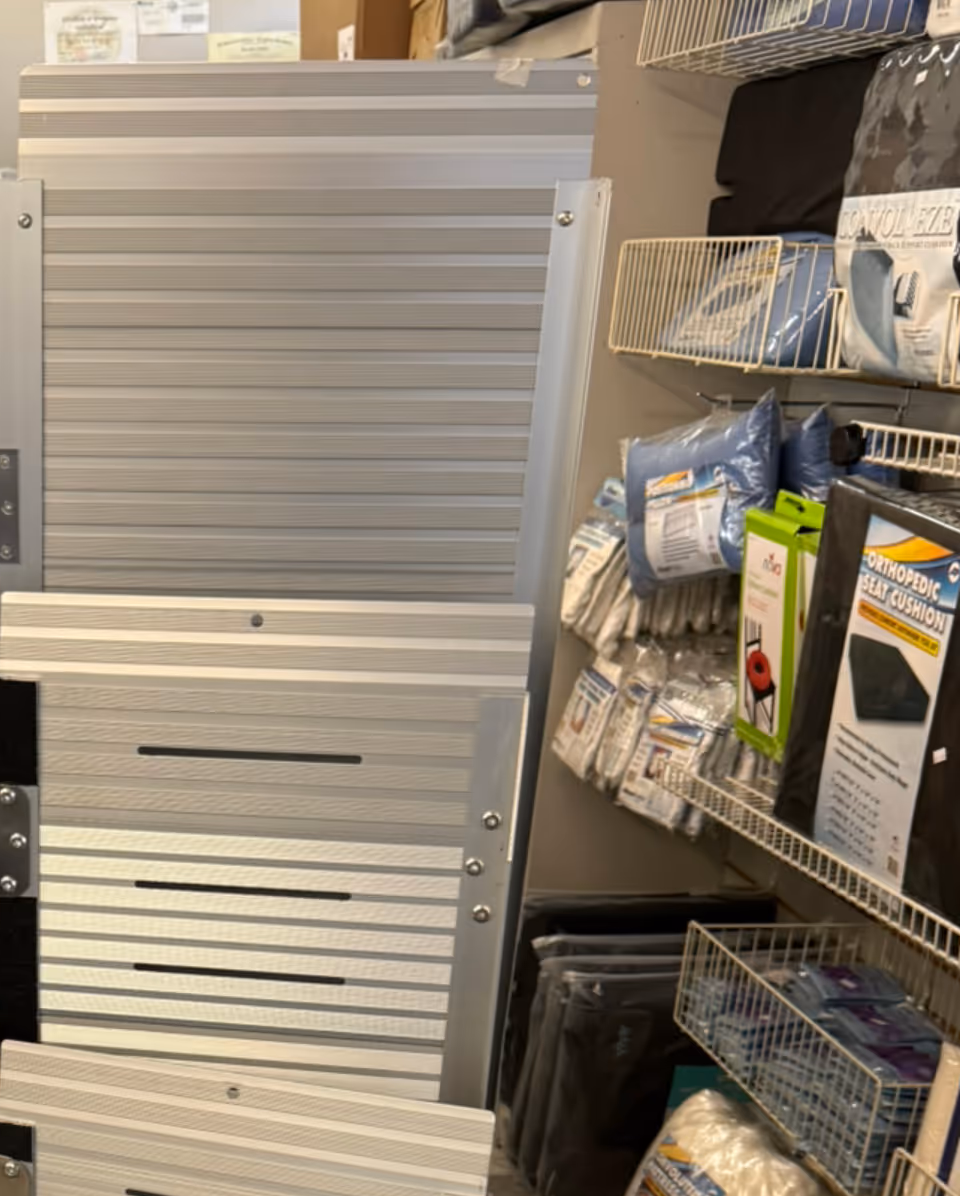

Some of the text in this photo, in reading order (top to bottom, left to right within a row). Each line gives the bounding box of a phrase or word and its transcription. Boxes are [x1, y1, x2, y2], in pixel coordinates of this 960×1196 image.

[862, 574, 889, 600] SEAT
[891, 589, 947, 633] CUSHION
[867, 552, 941, 602] ORTHOPEDIC
